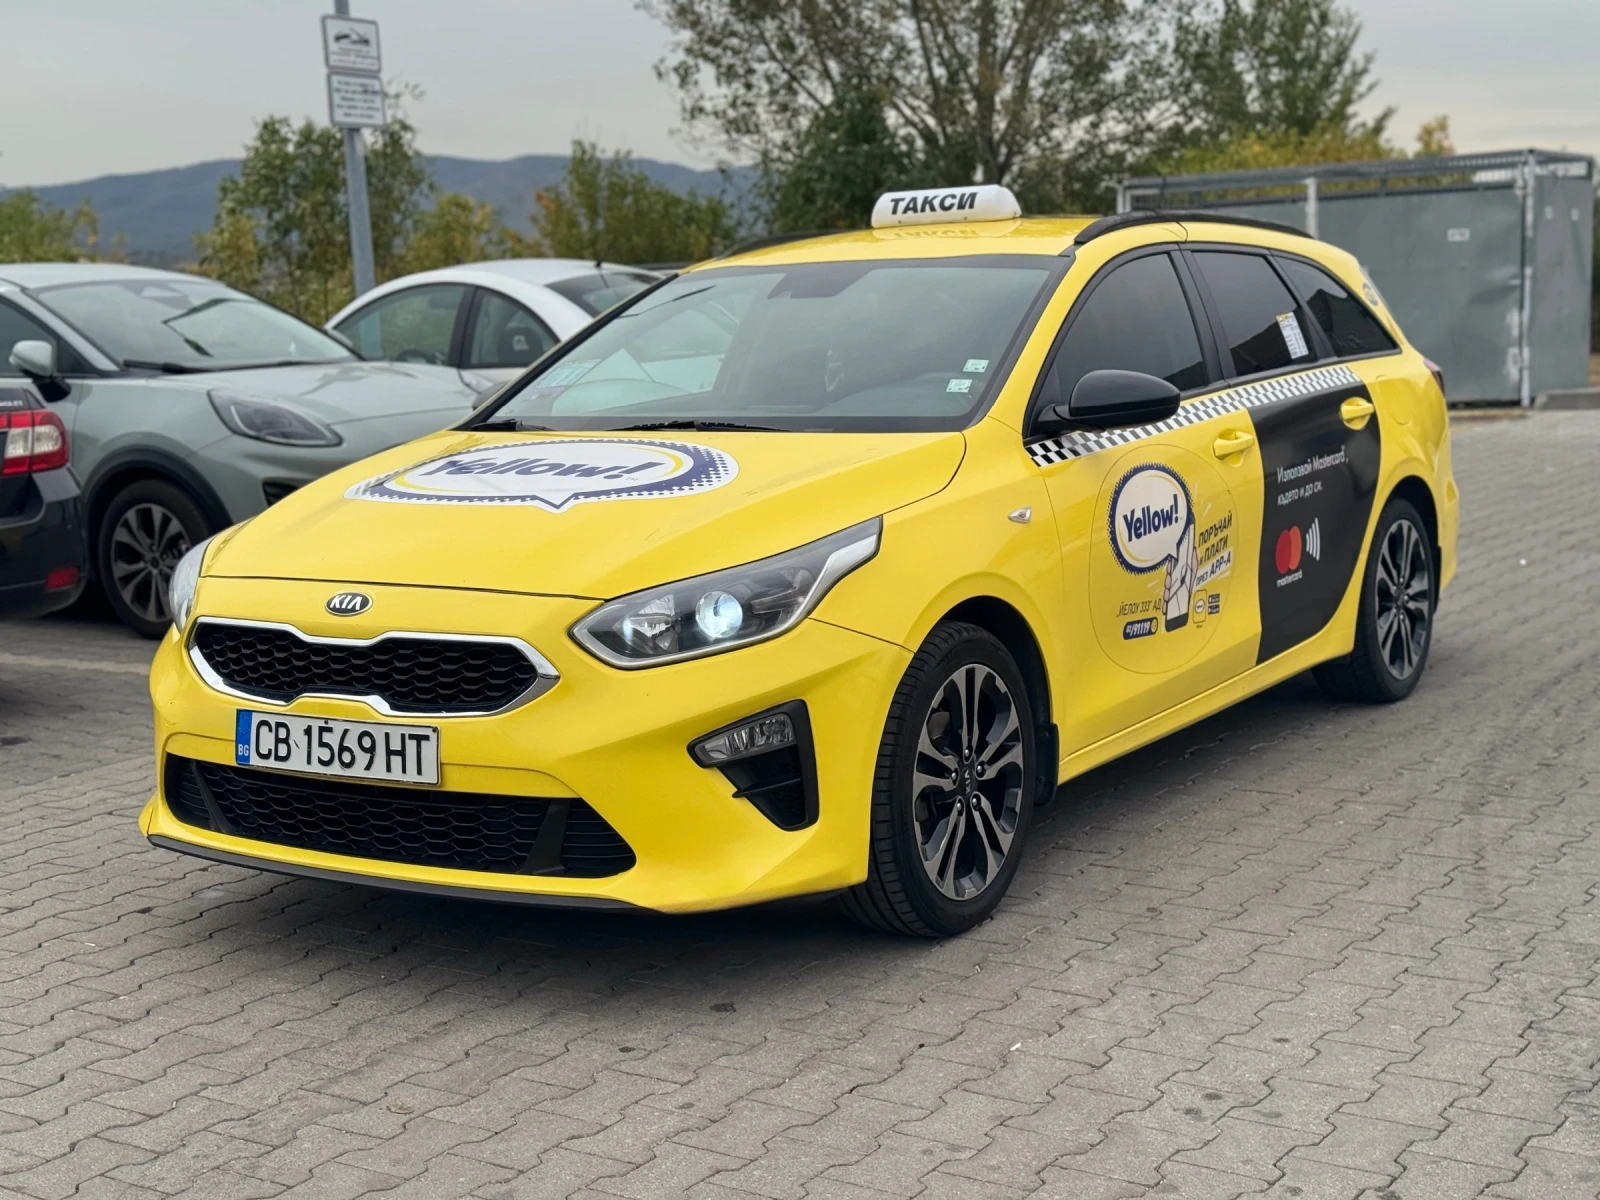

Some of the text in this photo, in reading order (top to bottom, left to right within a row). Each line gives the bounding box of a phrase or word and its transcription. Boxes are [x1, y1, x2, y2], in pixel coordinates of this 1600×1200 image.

[890, 192, 978, 215] ТАКСИ
[418, 457, 667, 480] Yellow!
[1278, 488, 1299, 506] където
[1305, 483, 1313, 498] до
[1122, 493, 1179, 543] Yellow!
[1198, 510, 1233, 548] ПОРЪЧАЙ
[1204, 534, 1229, 563] ПЛАТИ
[1196, 571, 1208, 587] ПРЕЗ
[1276, 568, 1302, 588] mastercard
[329, 594, 363, 611] KIA
[1153, 598, 1162, 613] АД
[238, 743, 250, 757] BG
[303, 724, 377, 771] 1569
